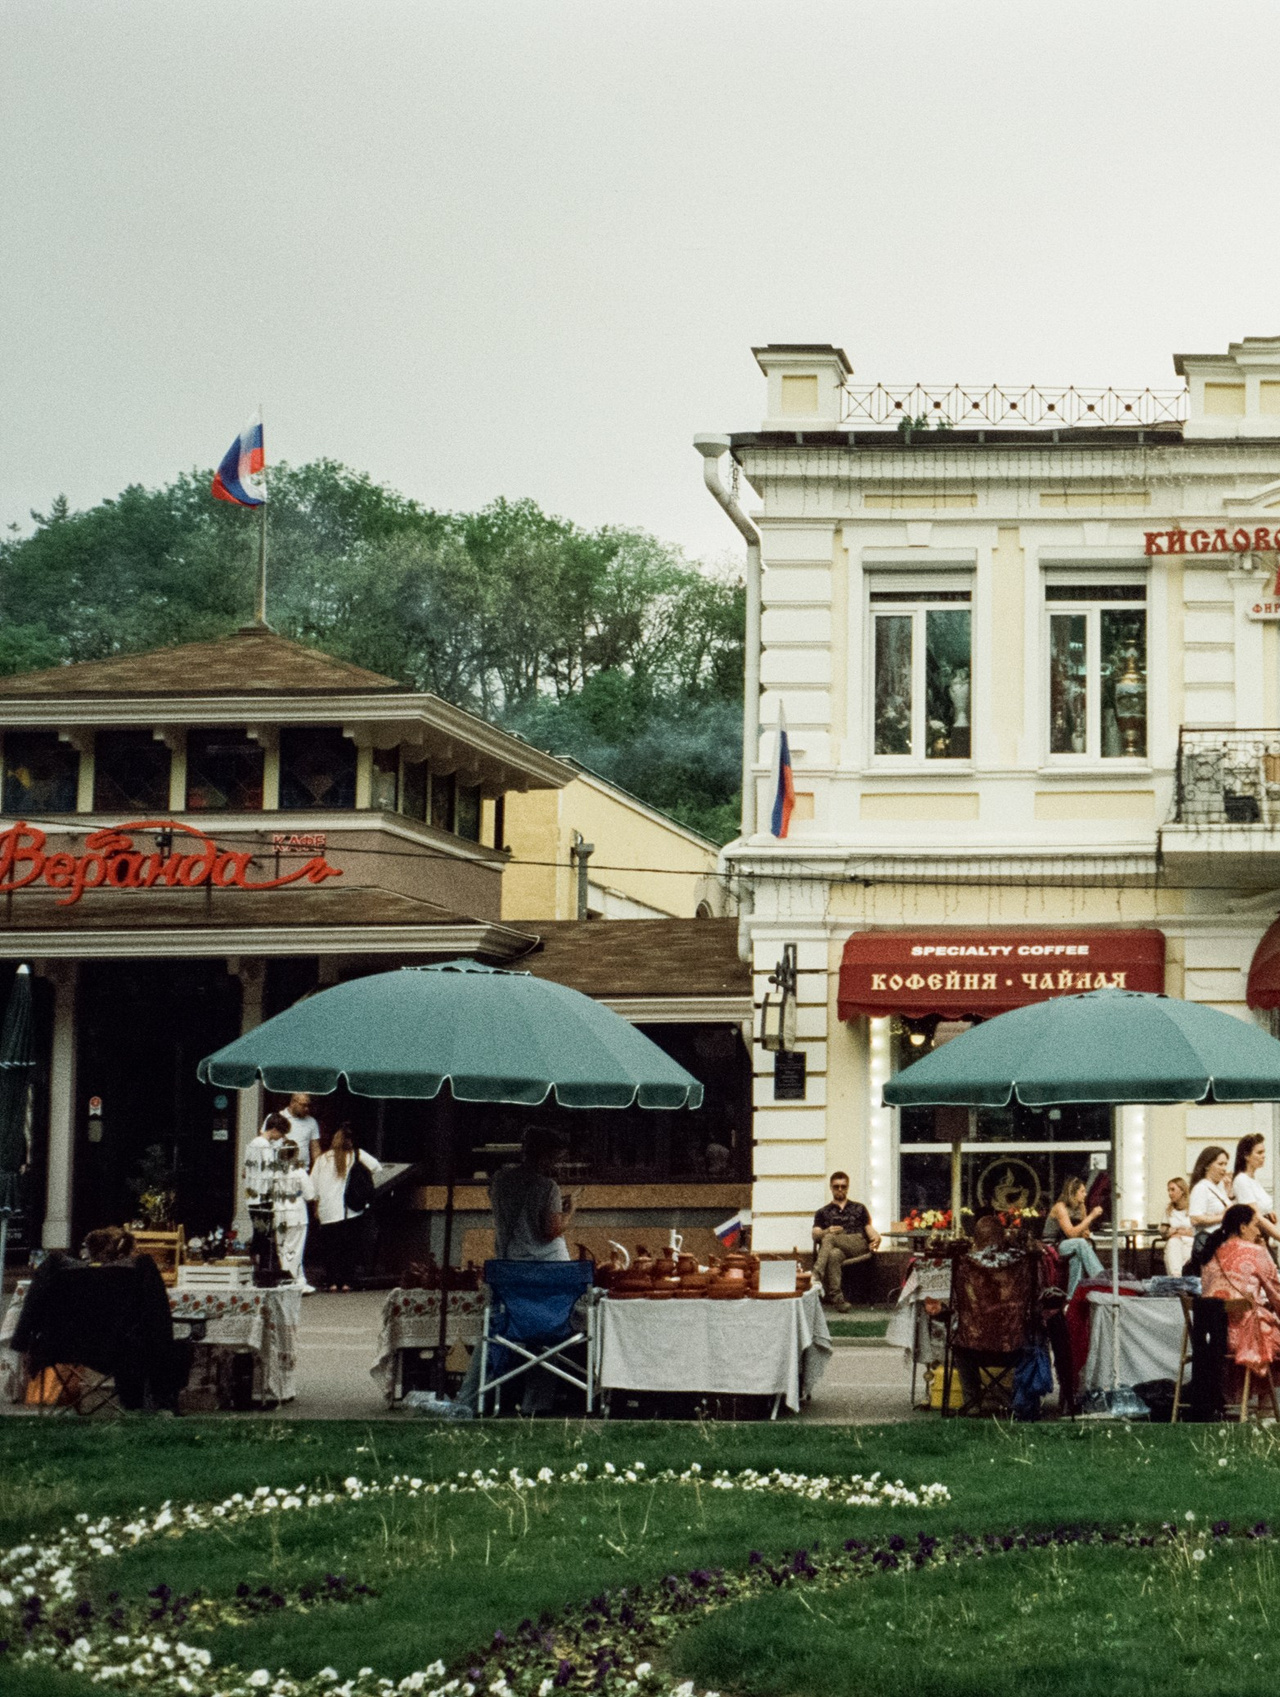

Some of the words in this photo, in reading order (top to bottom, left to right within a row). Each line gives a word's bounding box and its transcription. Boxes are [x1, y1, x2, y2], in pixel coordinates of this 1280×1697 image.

[272, 833, 327, 852] КАФЕ
[0, 820, 344, 906] Веранда
[911, 945, 1013, 957] SPECIALTY
[1017, 944, 1090, 956] COFFEE
[870, 969, 998, 991] КОФЕЙНЯ
[1021, 969, 1128, 990] ЧАЙНАЯ
